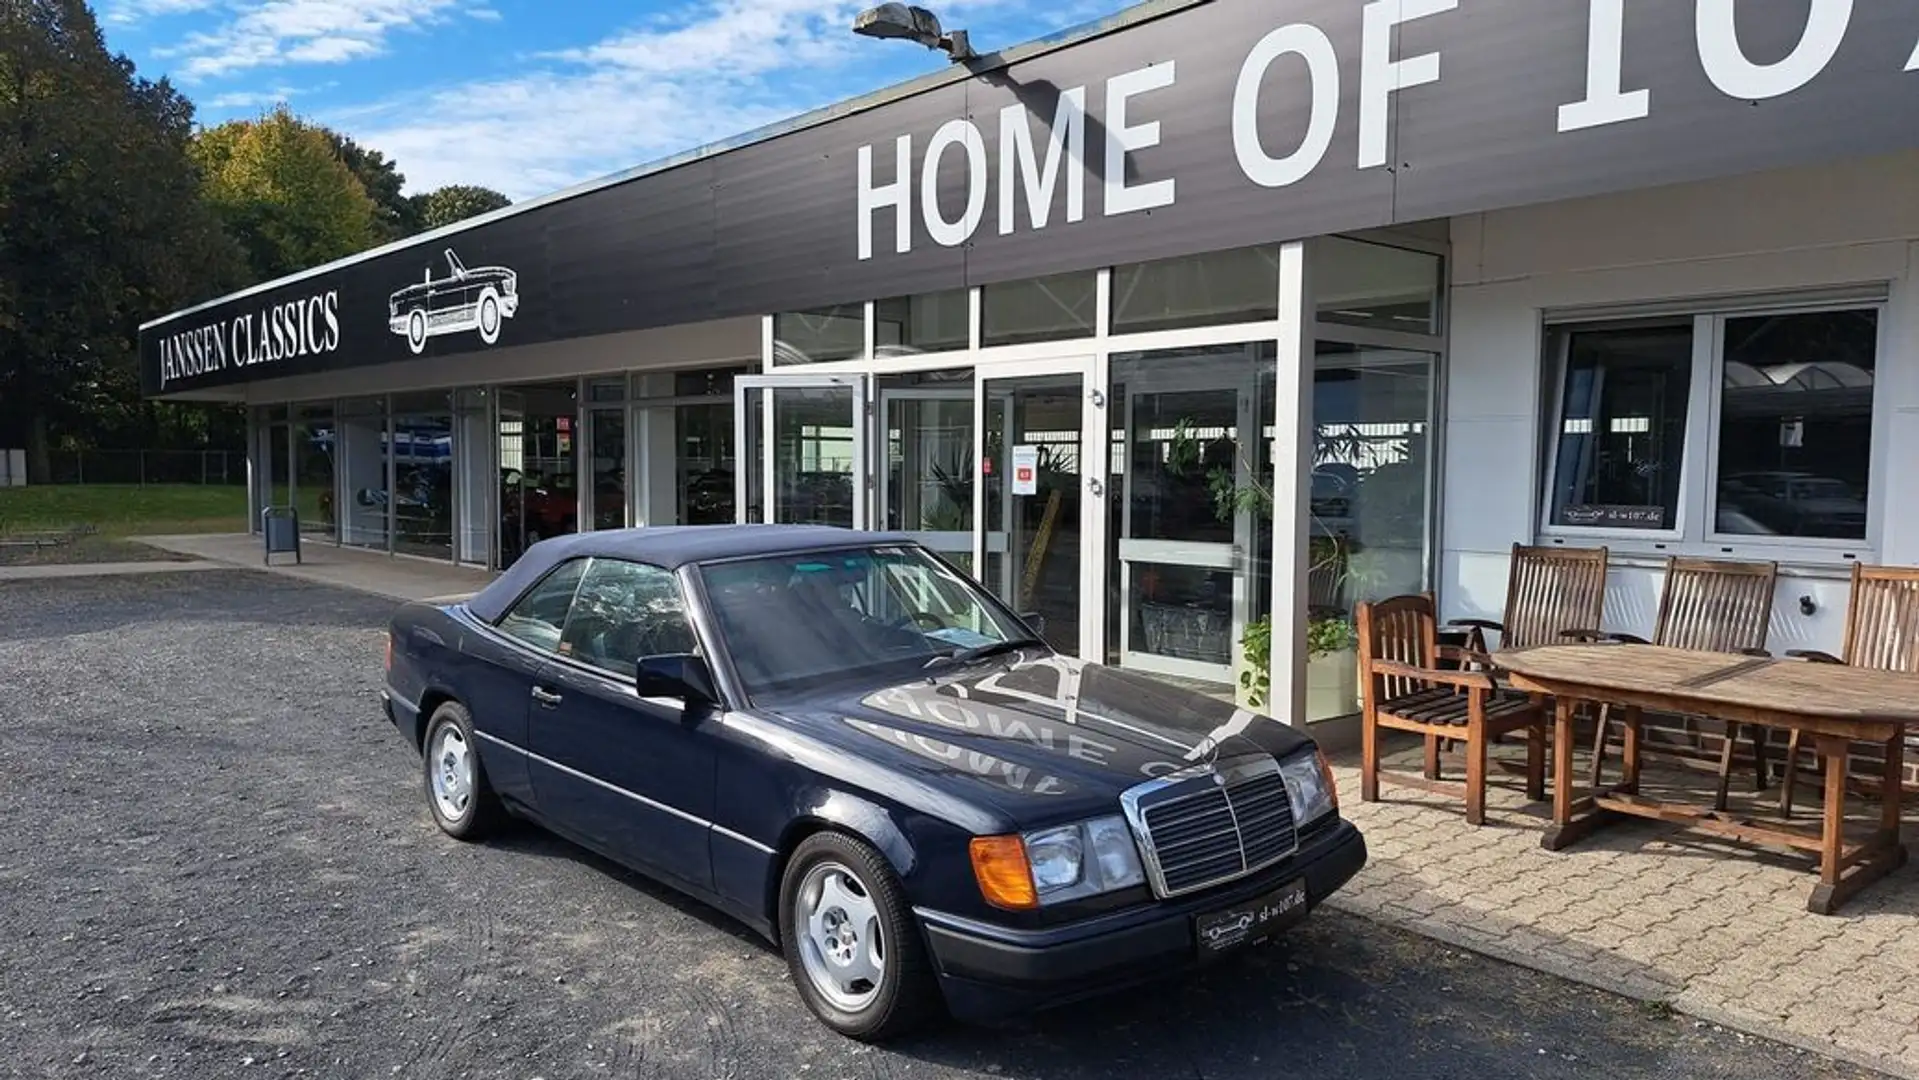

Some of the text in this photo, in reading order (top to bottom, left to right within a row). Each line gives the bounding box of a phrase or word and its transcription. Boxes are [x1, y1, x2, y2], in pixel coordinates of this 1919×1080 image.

[857, 59, 1176, 260] HOME
[1232, 0, 1459, 188] OF
[159, 290, 339, 390] JANSSEN CLASSICS
